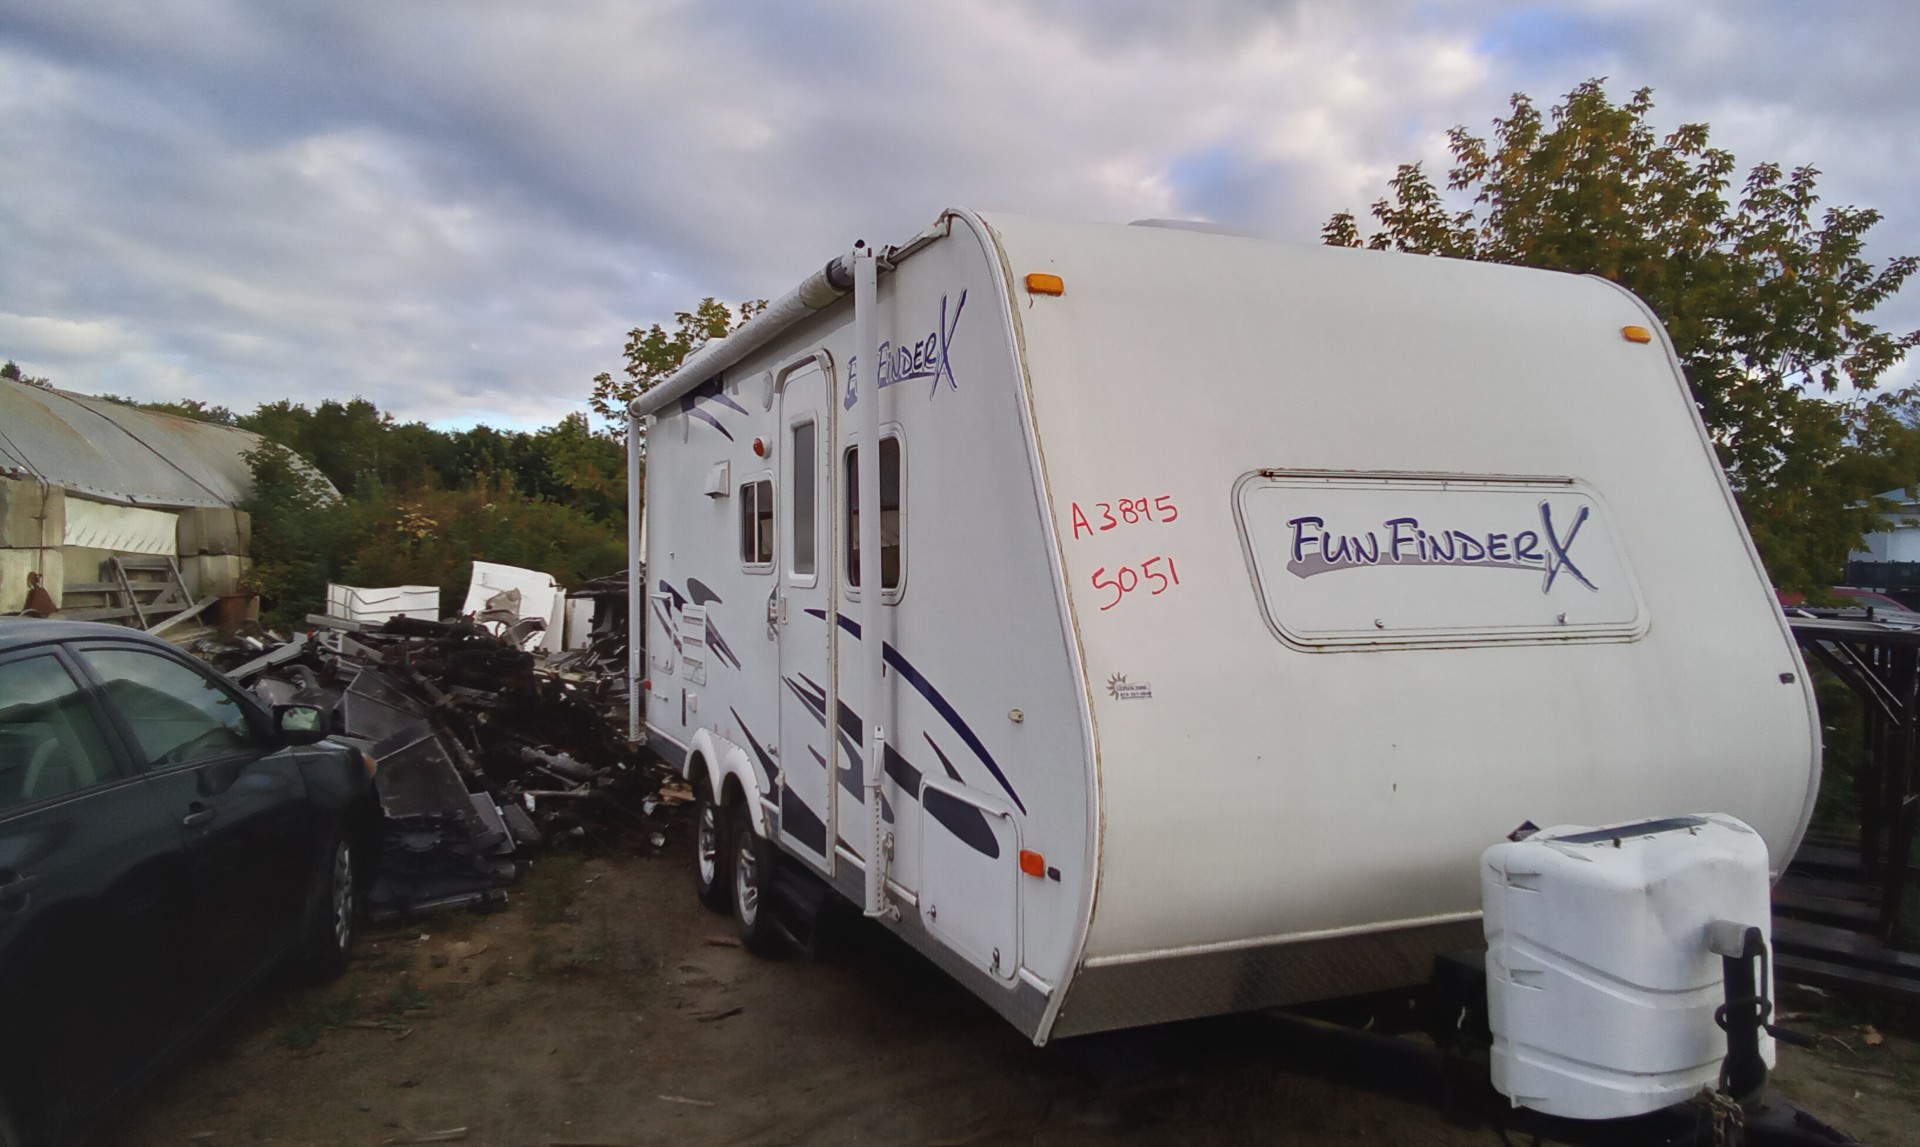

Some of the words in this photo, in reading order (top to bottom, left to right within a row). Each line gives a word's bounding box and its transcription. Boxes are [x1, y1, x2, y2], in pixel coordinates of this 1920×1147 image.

[1072, 495, 1178, 540] A3895
[1288, 516, 1379, 564] FUN
[1091, 556, 1180, 611] 5051
